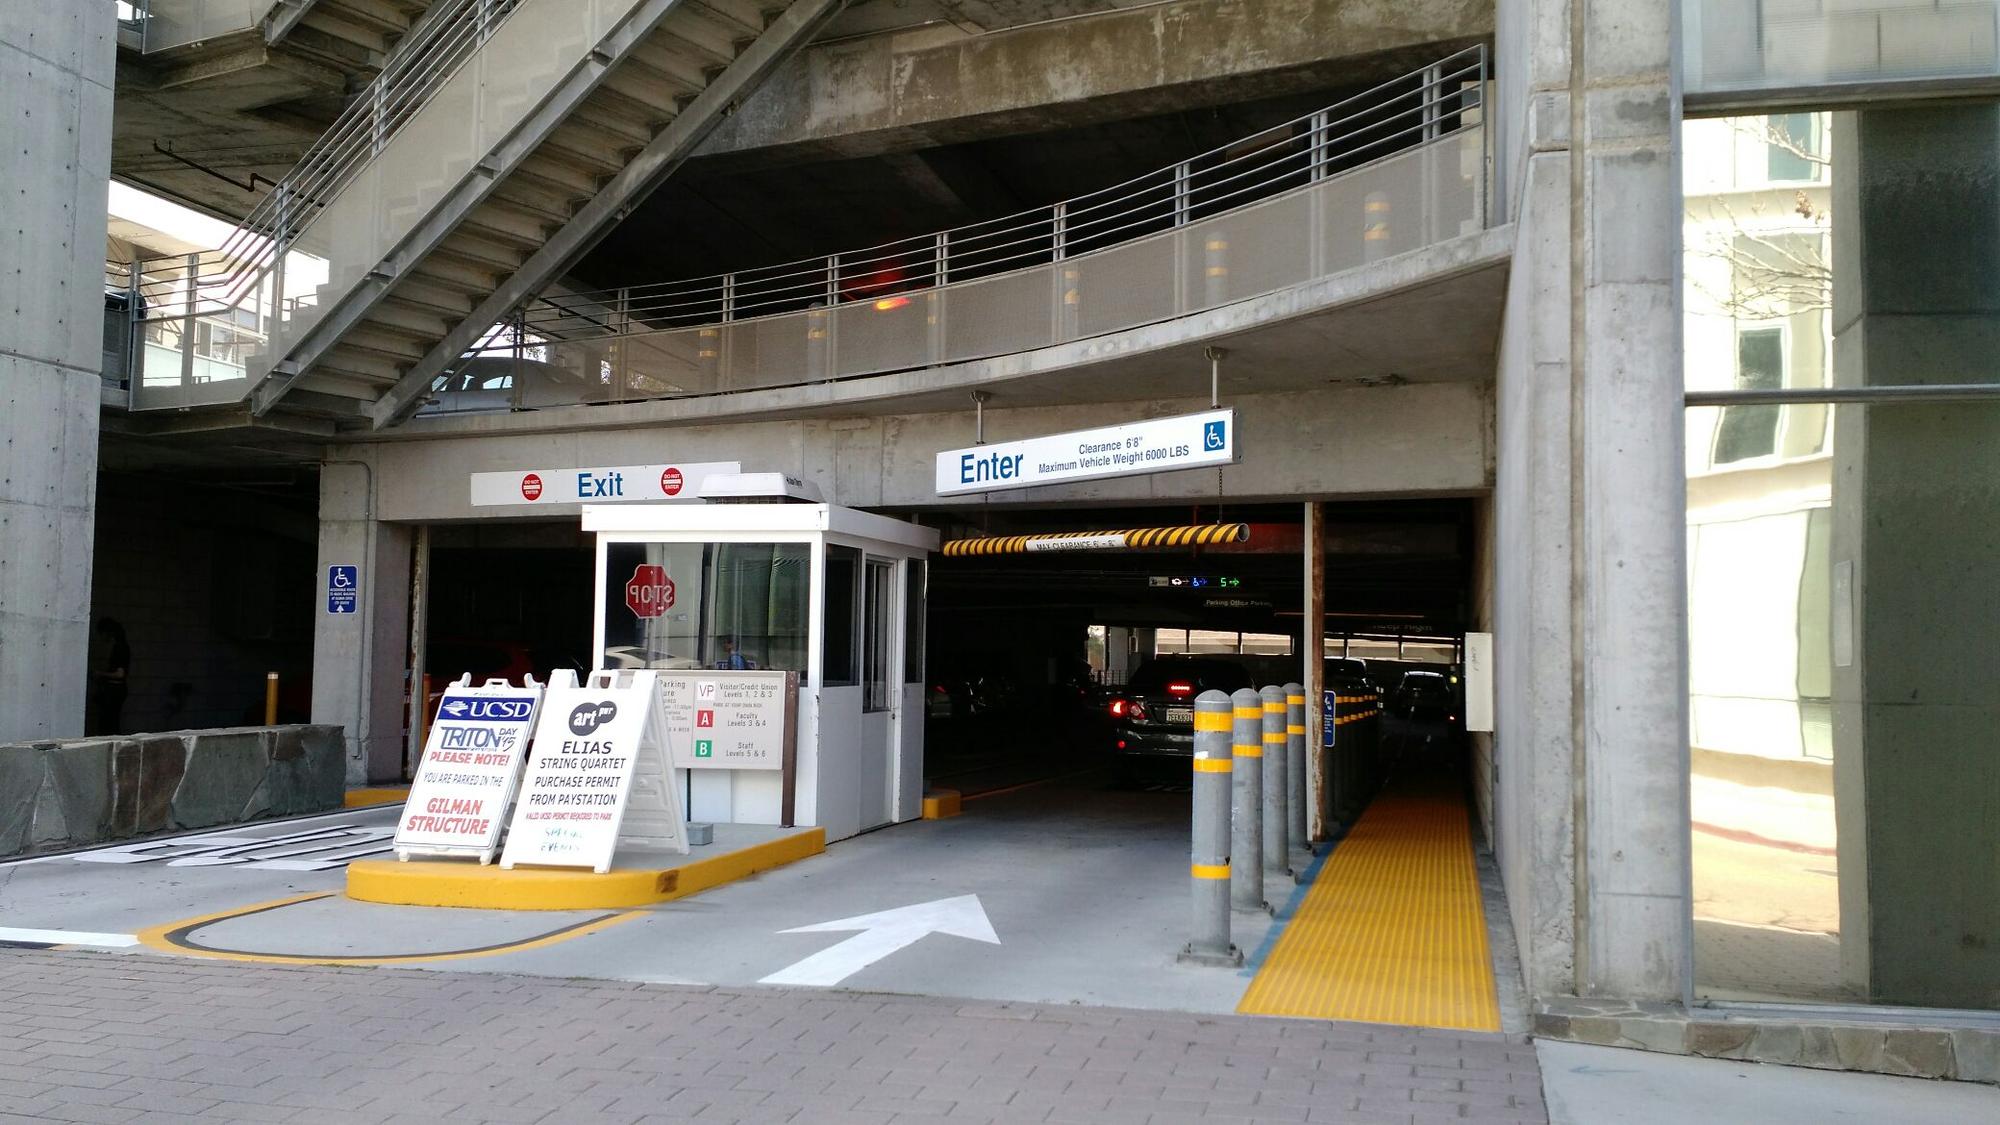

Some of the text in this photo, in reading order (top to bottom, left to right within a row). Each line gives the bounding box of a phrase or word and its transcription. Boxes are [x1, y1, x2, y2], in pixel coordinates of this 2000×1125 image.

[1079, 436, 1143, 454] Clearance 6'8"
[1038, 445, 1190, 474] Maximum Vehicle Weight 6000 LBS
[961, 452, 1023, 484] Enter
[578, 472, 624, 497] Exit
[1036, 542, 1051, 550] MAX
[1052, 540, 1092, 550] CLEARANCE
[699, 684, 714, 697] VP
[470, 702, 532, 718] UCSD
[573, 709, 597, 727] art
[701, 712, 709, 725] A
[440, 726, 502, 750] TRITON
[561, 741, 613, 755] ELIAS
[700, 743, 708, 755] B
[430, 751, 510, 766] PLEASE NOTE!
[539, 757, 626, 771] STRING QUARTET
[423, 772, 504, 787] YOU ARE PARKED IN THE
[534, 776, 621, 788] PURCHASE PERMIT
[427, 797, 483, 815] GILMAN
[529, 794, 617, 806] FROM PAYSTATION
[406, 815, 490, 835] STRUCTURE
